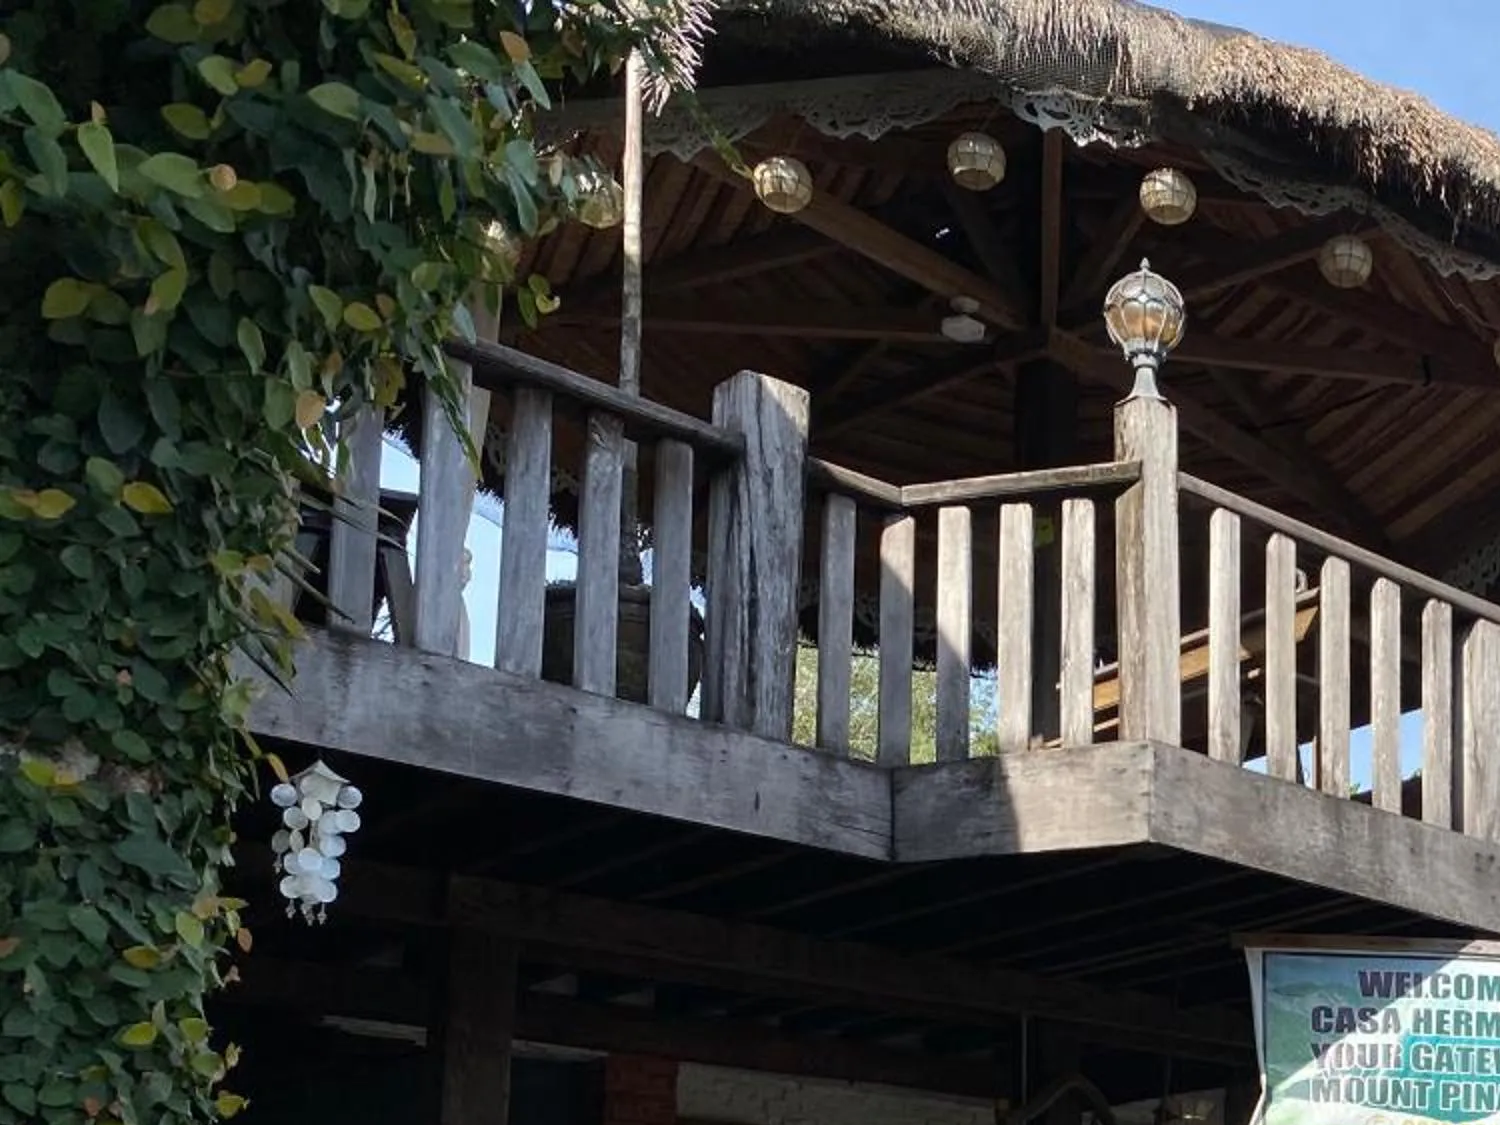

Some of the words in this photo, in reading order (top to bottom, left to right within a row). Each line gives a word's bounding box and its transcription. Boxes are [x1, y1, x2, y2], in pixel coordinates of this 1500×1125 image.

[1311, 1005, 1401, 1034] CASA
[1311, 1043, 1402, 1070] YOUR
[1311, 1078, 1432, 1109] MOUNT
